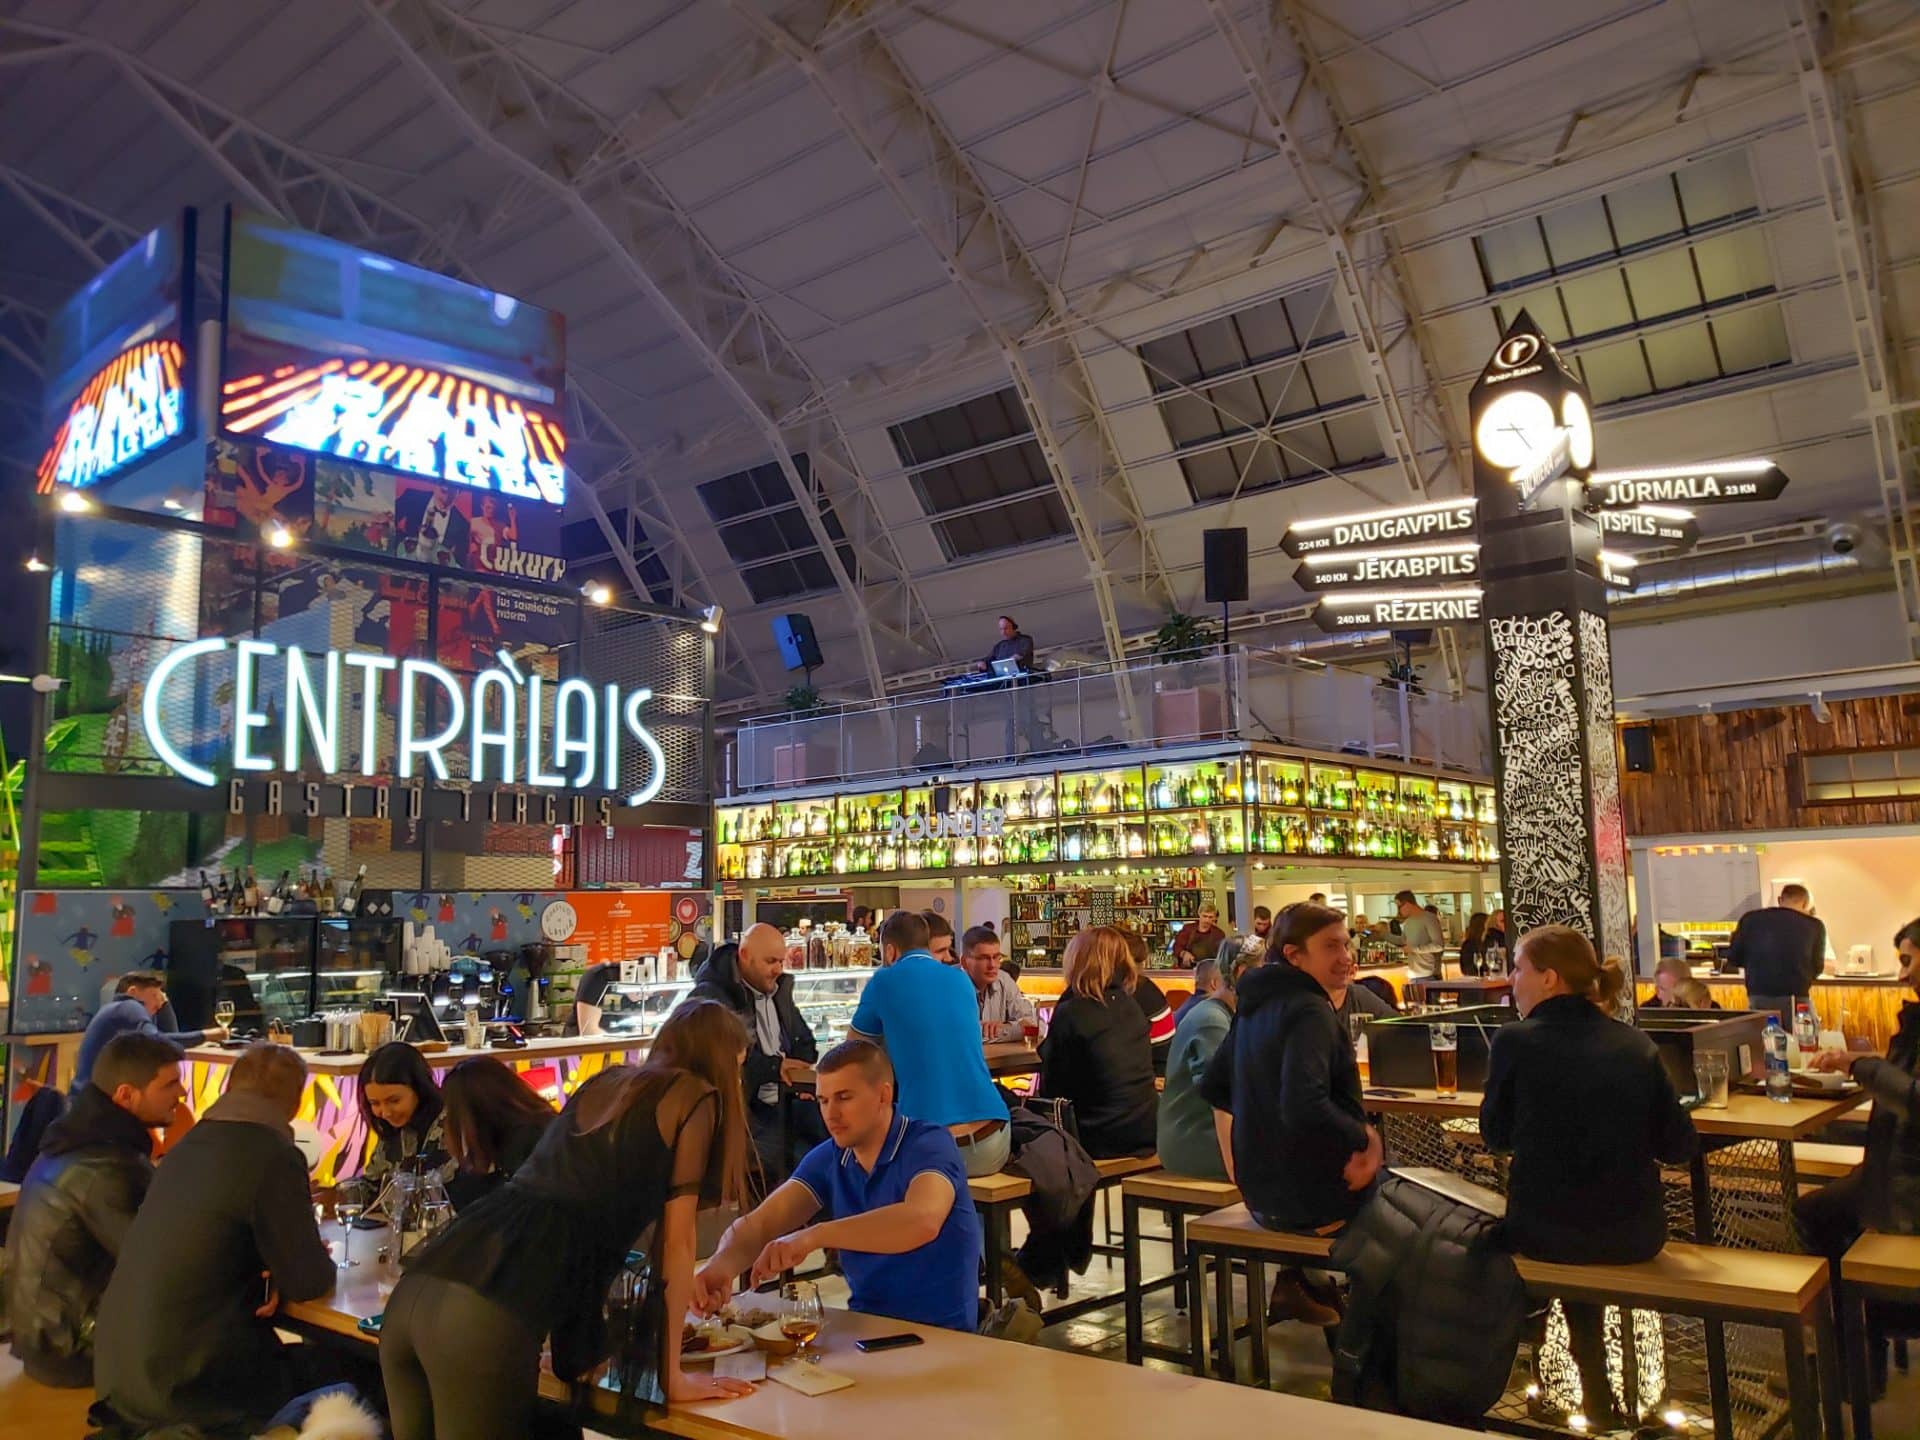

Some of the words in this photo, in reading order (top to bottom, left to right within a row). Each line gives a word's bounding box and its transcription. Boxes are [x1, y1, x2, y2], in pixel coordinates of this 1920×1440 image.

[1604, 477, 1720, 505] JŪRMALA
[1725, 485, 1738, 496] 23
[1740, 484, 1756, 495] KM
[1298, 540, 1315, 551] 224
[1315, 538, 1330, 548] KM
[1334, 509, 1472, 546] DAUGAVPILS
[1314, 574, 1332, 585] 140
[1333, 573, 1348, 583] KM
[1353, 554, 1475, 581] JĒKABPILS
[1337, 615, 1354, 626] 240
[1355, 614, 1370, 625] KM
[1375, 600, 1480, 623] RĒZEKNE
[1522, 647, 1574, 669] Dobele
[229, 779, 422, 821] GASTRO
[461, 790, 612, 827] TIRGUS
[889, 808, 1005, 841] POUNDER
